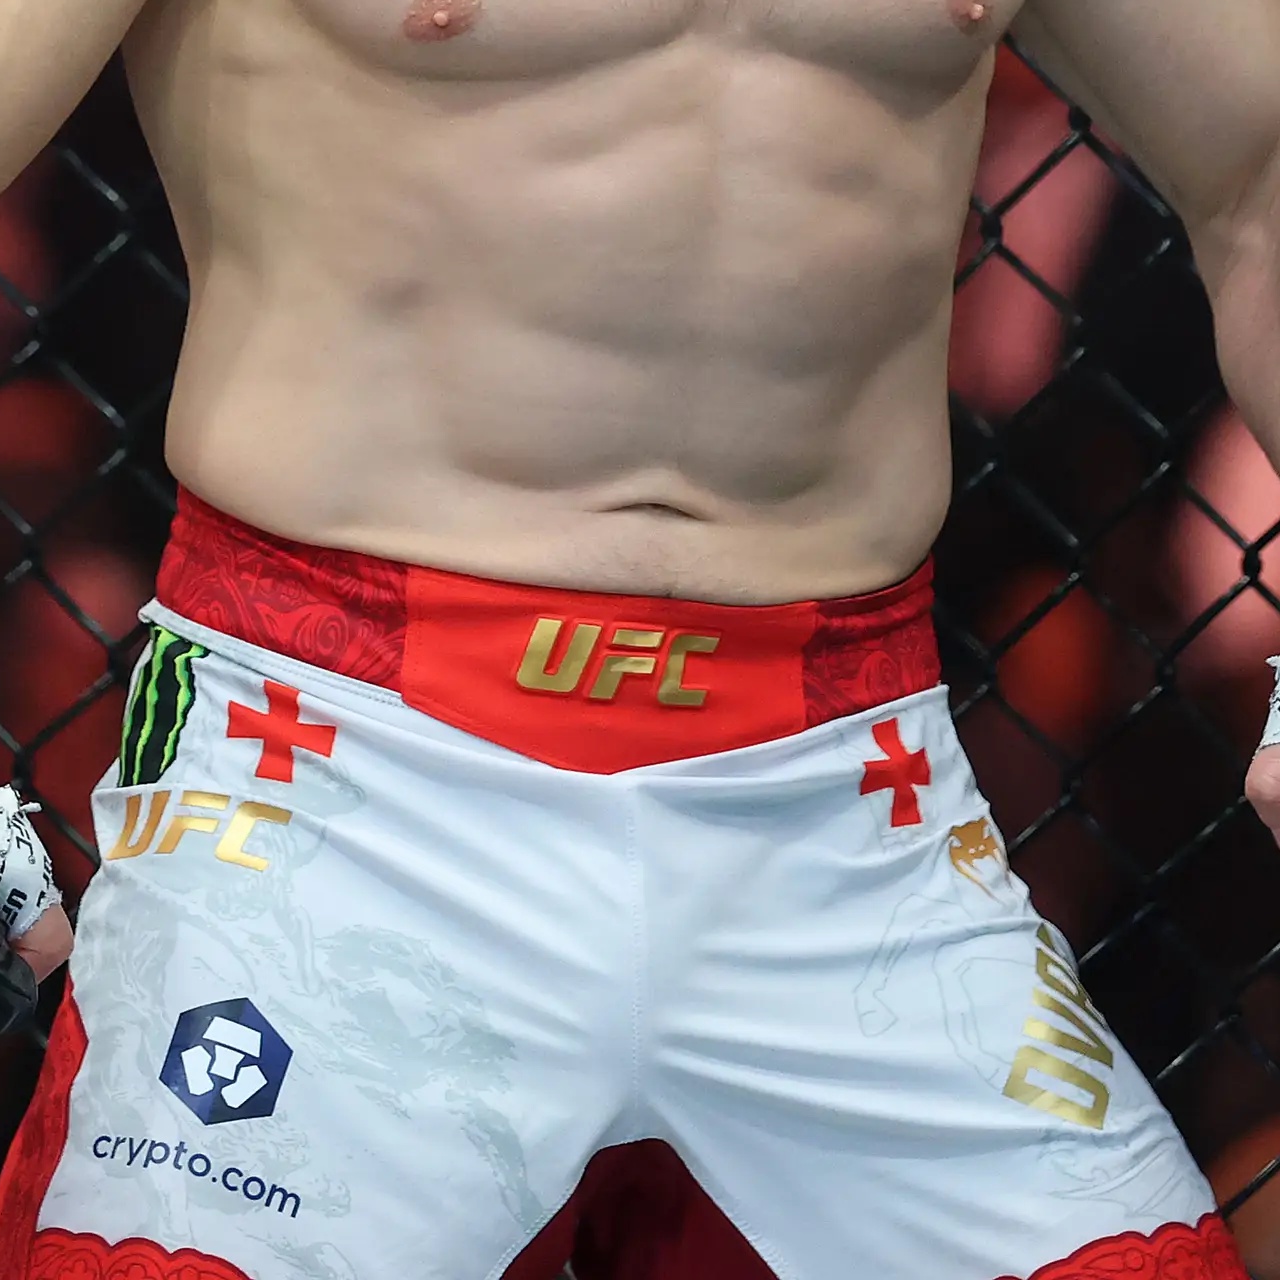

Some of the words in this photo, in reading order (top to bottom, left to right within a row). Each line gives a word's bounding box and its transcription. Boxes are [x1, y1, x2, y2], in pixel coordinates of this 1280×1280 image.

[516, 617, 719, 707] UFC
[106, 789, 294, 873] UFC
[1001, 923, 1114, 1131] DVA
[92, 1134, 302, 1219] crypto.com
